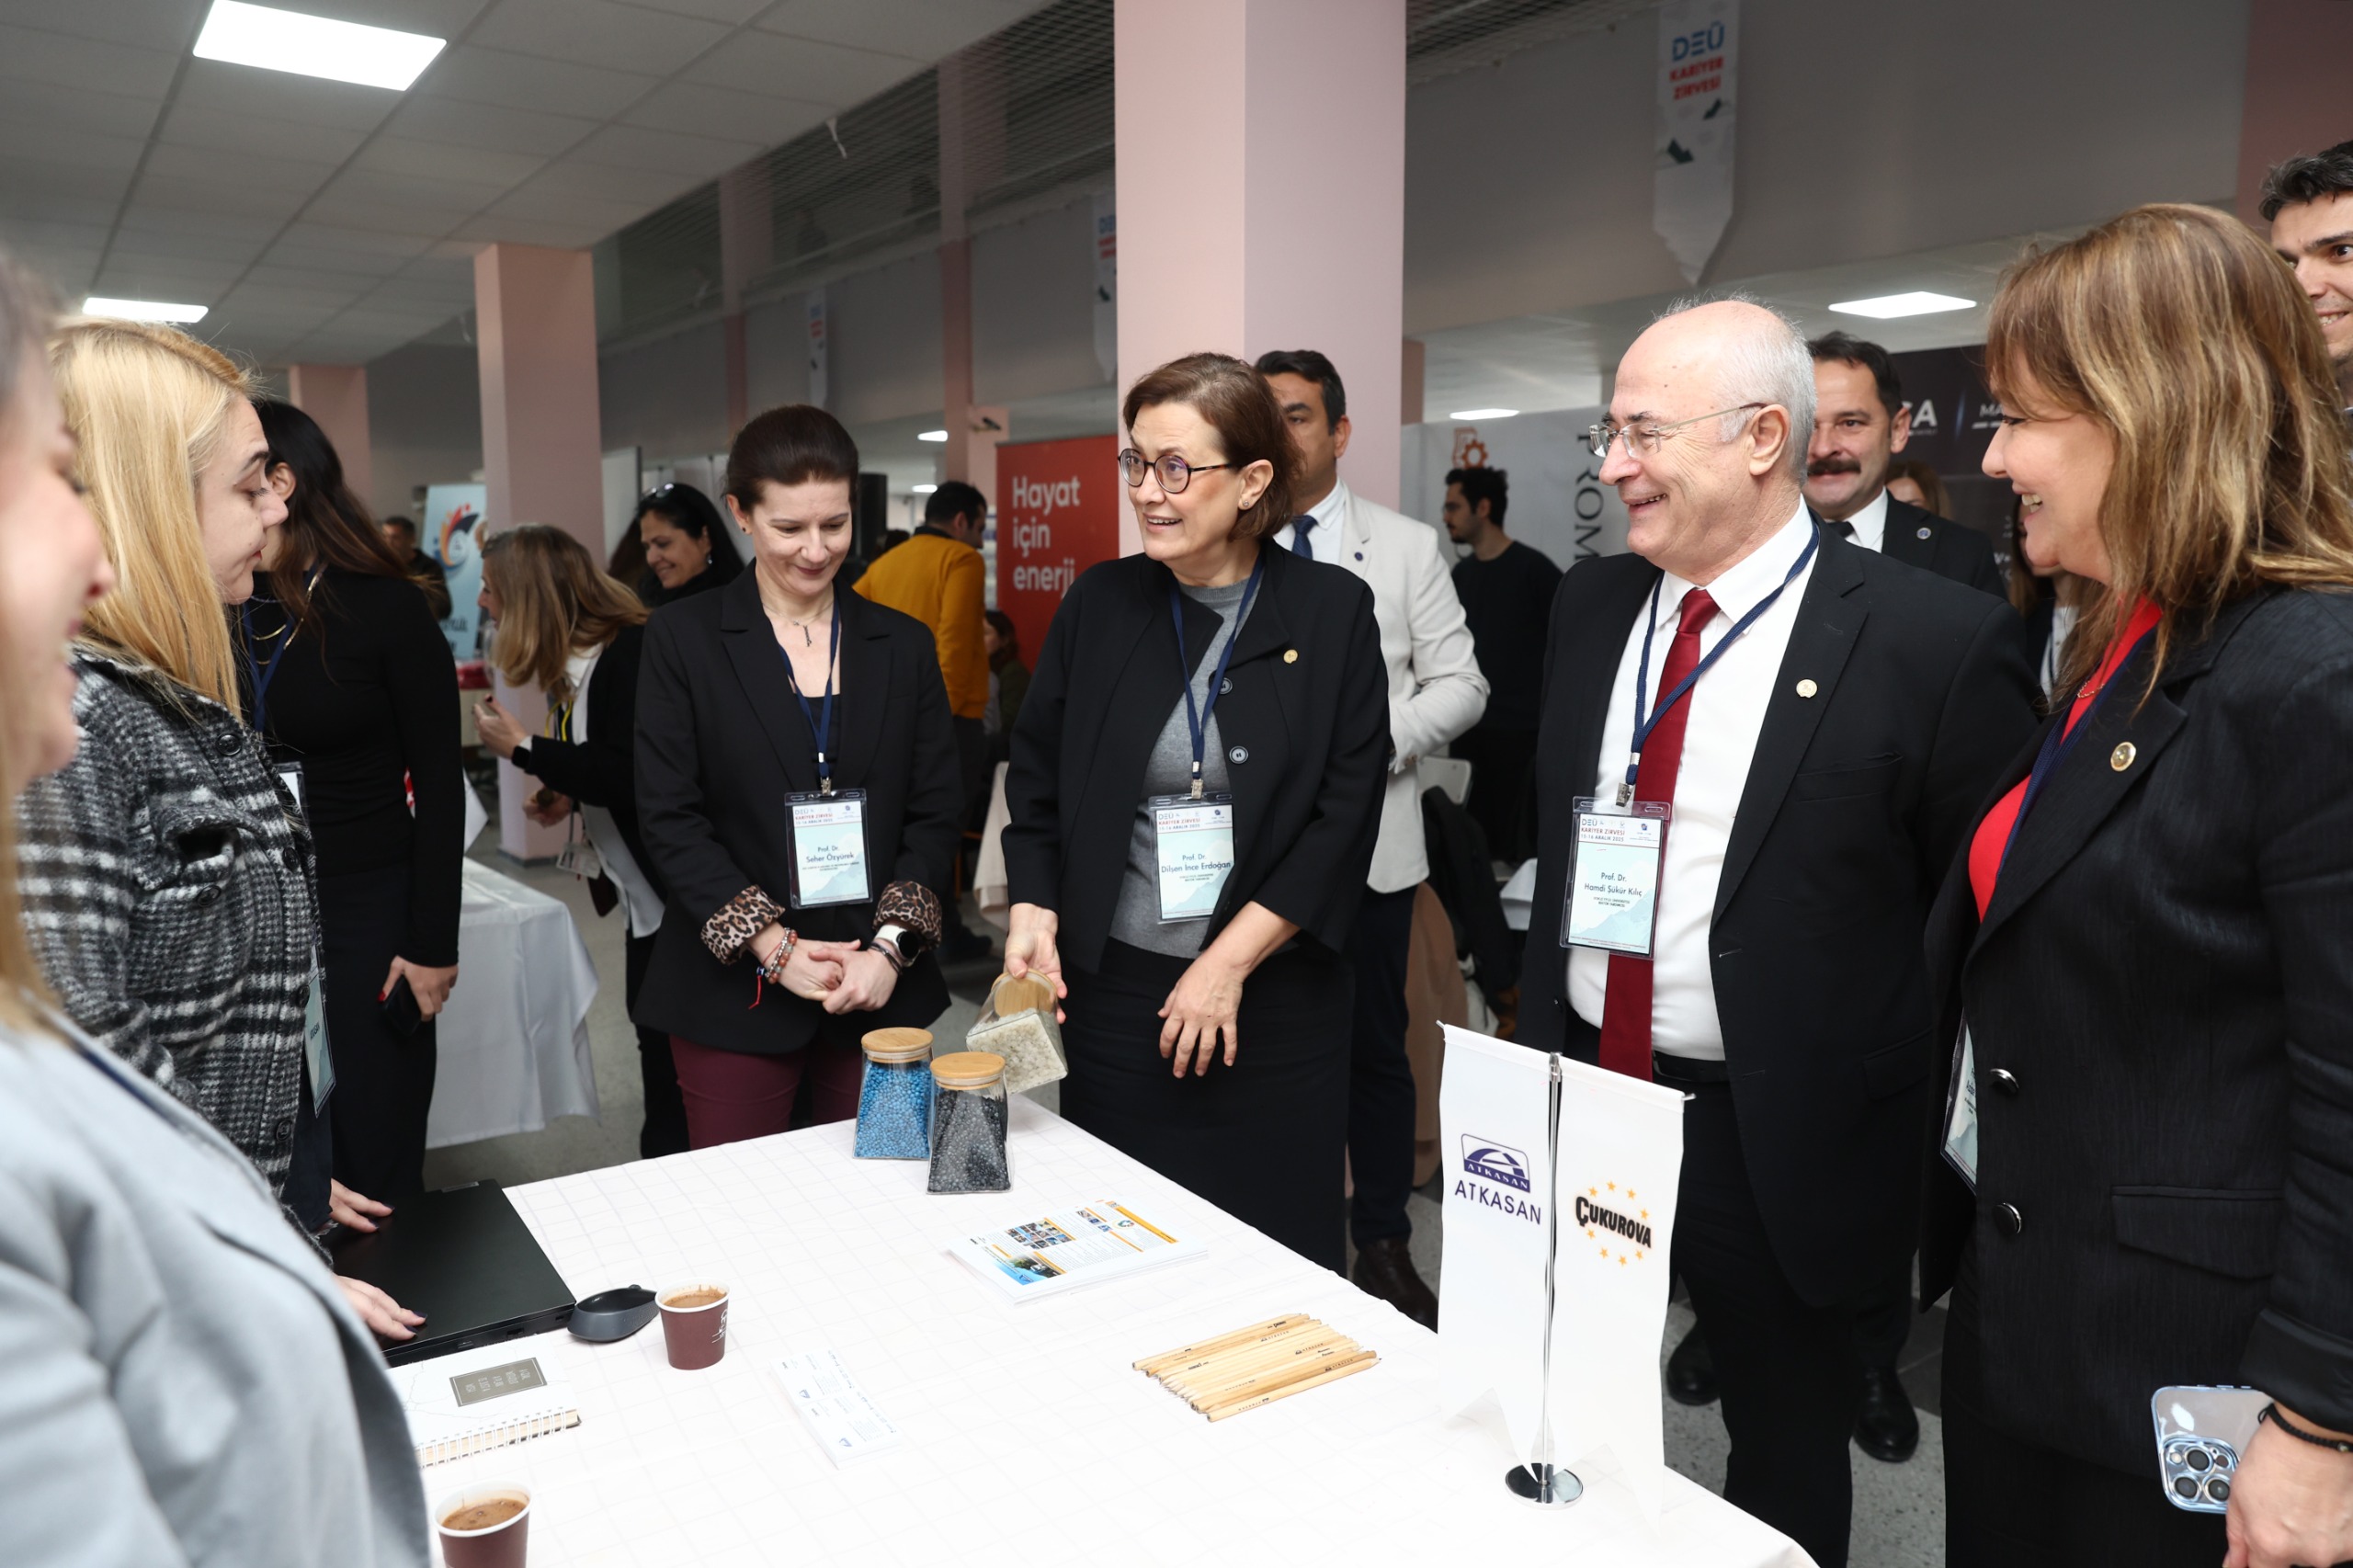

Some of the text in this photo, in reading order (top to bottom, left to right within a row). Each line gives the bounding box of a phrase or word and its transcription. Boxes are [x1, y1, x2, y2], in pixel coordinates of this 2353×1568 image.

[1672, 20, 1725, 62] DEÜ
[1013, 476, 1080, 516] Hayat
[1013, 517, 1051, 558] için
[1581, 818, 1597, 827] DEÜ
[1200, 861, 1232, 871] Erdoğan
[1600, 872, 1627, 882] Prof. Dr.
[1467, 1163, 1529, 1190] ATKASAN
[1454, 1179, 1541, 1225] ATKASAN
[1575, 1196, 1652, 1249] ÇUKUROVA
